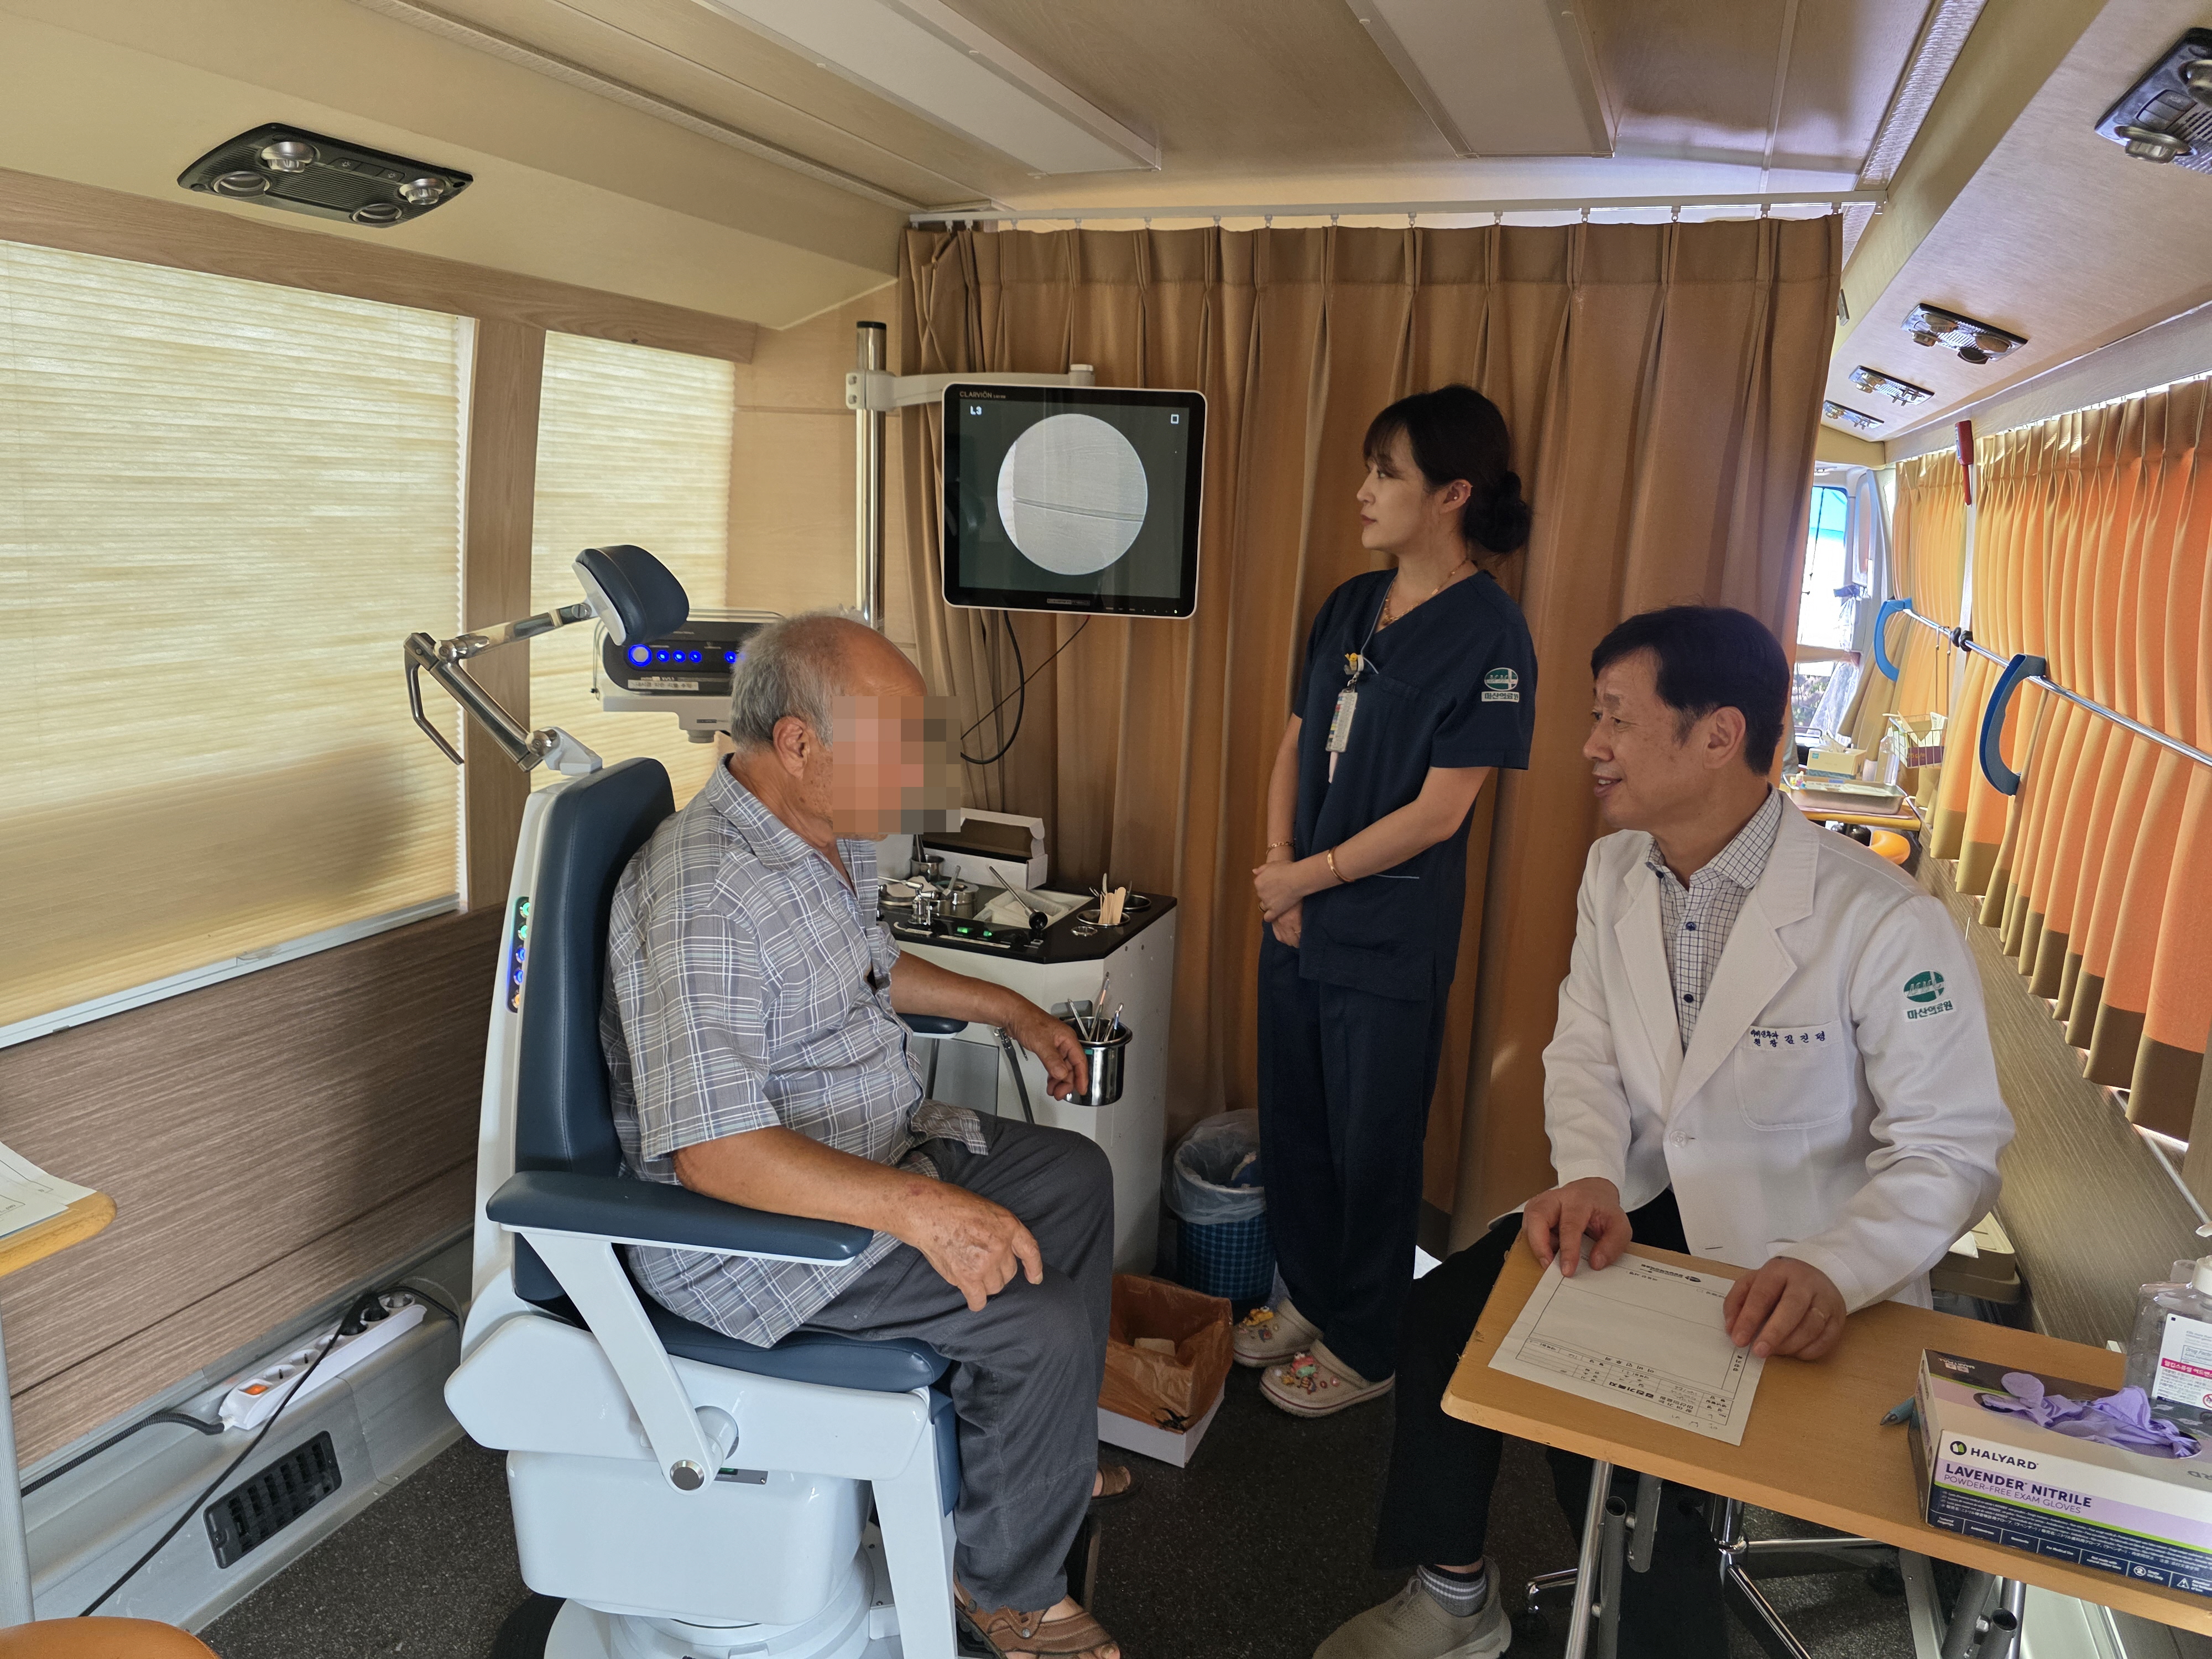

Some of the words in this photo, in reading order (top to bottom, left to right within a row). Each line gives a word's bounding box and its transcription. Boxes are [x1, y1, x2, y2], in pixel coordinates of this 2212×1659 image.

[1907, 1000, 1953, 1019] 마산의료원
[1609, 1381, 1654, 1399] 검진기록지
[1970, 1448, 2037, 1470] HALYARD
[1944, 1474, 2012, 1496] POWDER-FREE
[2014, 1492, 2040, 1504] EXAM
[2043, 1499, 2081, 1514] GLOVES
[1945, 1463, 2025, 1491] LAVENDER
[2031, 1484, 2092, 1507] NITRILE
